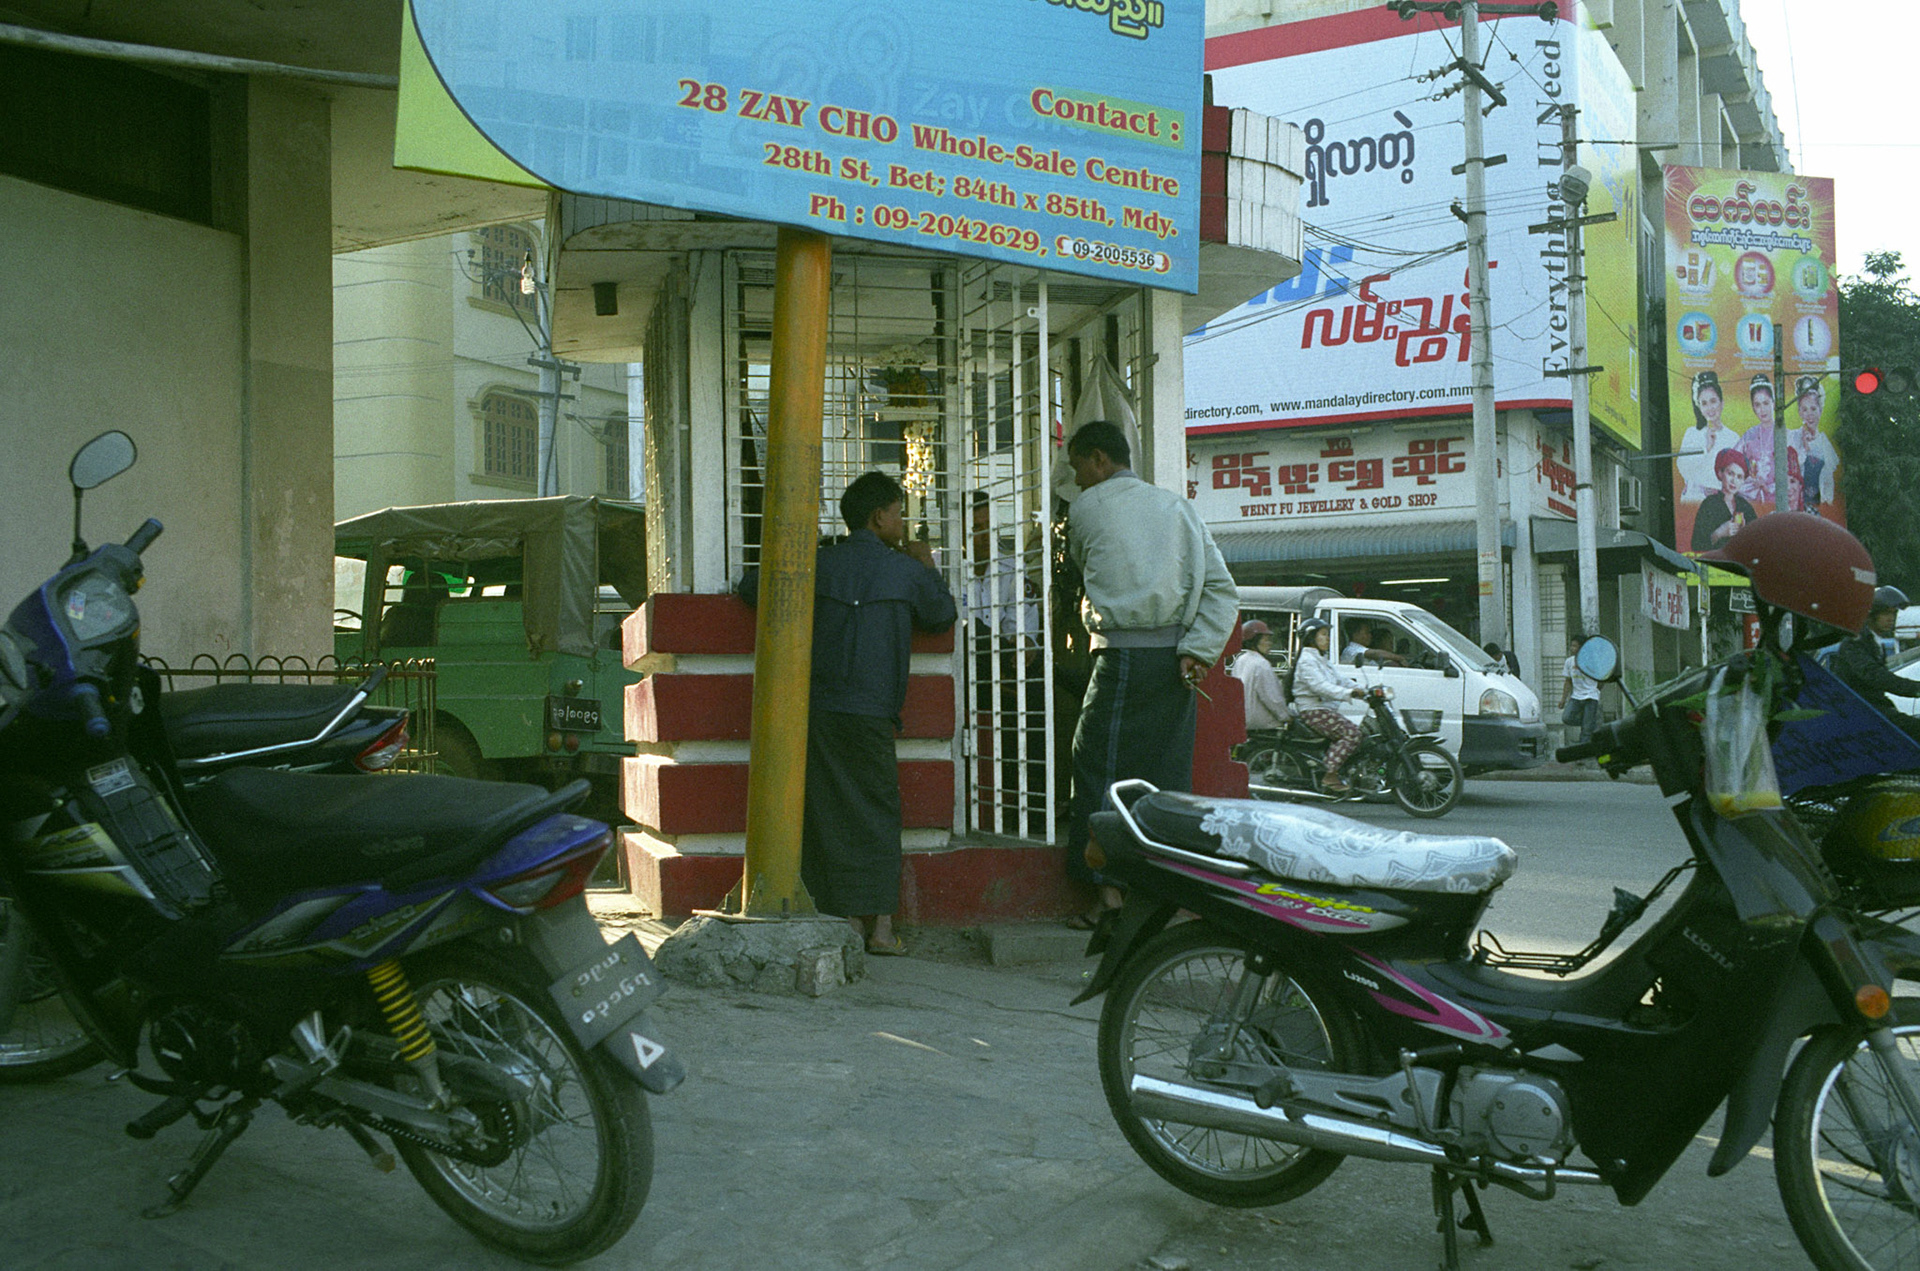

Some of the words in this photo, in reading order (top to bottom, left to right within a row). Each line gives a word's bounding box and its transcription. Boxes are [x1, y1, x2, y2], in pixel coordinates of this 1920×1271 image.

[1535, 39, 1563, 127] Need
[678, 79, 728, 114] 28
[737, 88, 811, 128] ZAY
[818, 105, 899, 143] CHO
[911, 123, 1078, 178] Whole-Sale
[1084, 157, 1180, 198] Centre
[1030, 87, 1160, 138] Contact
[1287, 110, 1415, 208] ရှိလာတဲ့
[1538, 142, 1564, 169] U
[764, 143, 832, 176] 28th
[839, 157, 881, 187] St,
[889, 164, 946, 197] Bet;
[953, 176, 1017, 208] 84th
[1022, 192, 1040, 212] x
[1045, 193, 1116, 228] 85th,
[1122, 206, 1179, 240] Mdy.
[809, 193, 847, 222] Ph
[872, 204, 1049, 257] 09-2042629,
[1072, 241, 1156, 268] 09-2005536
[1184, 403, 1264, 421] directory.com,
[1270, 385, 1474, 413] www.mandalaydirectory.com.mm
[1240, 503, 1277, 517] WEINT
[1279, 502, 1294, 515] FU
[1296, 498, 1355, 514] JEWELLERY
[1359, 497, 1369, 509] &
[1371, 495, 1402, 508] GOLD
[1408, 493, 1438, 507] SHOP
